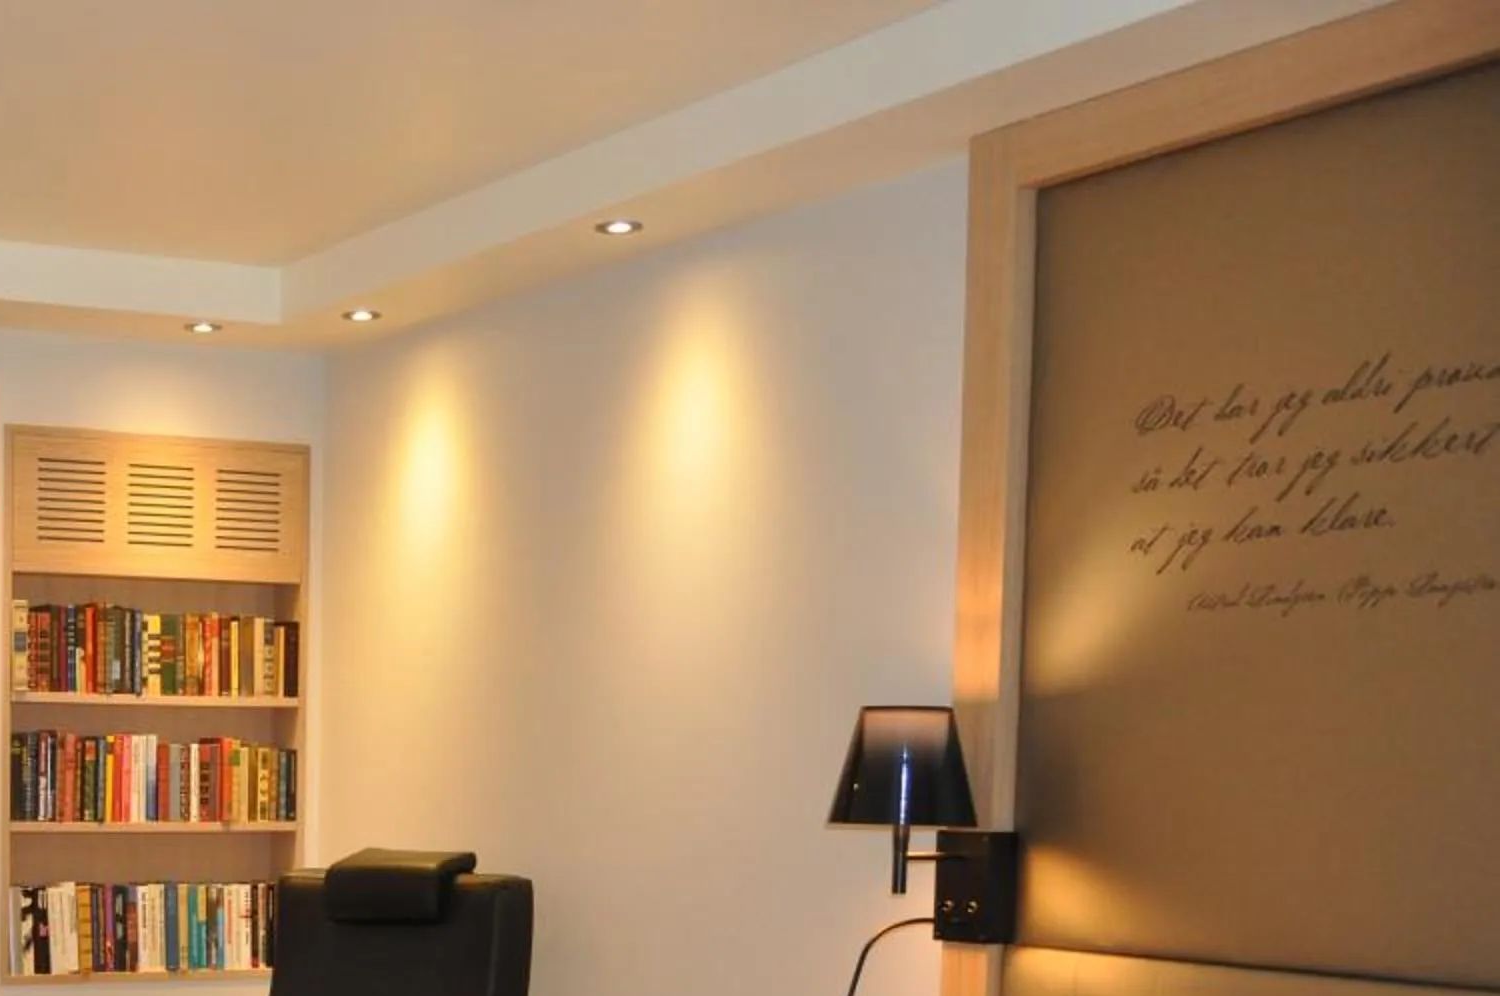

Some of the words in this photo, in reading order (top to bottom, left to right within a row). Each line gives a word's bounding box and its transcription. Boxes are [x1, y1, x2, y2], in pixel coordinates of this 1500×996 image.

[1134, 394, 1213, 436] Det
[1249, 388, 1314, 445] jeg
[1274, 445, 1342, 503] jeg
[1130, 523, 1171, 556] at
[1156, 521, 1213, 576] jeg
[1223, 505, 1284, 545] kan
